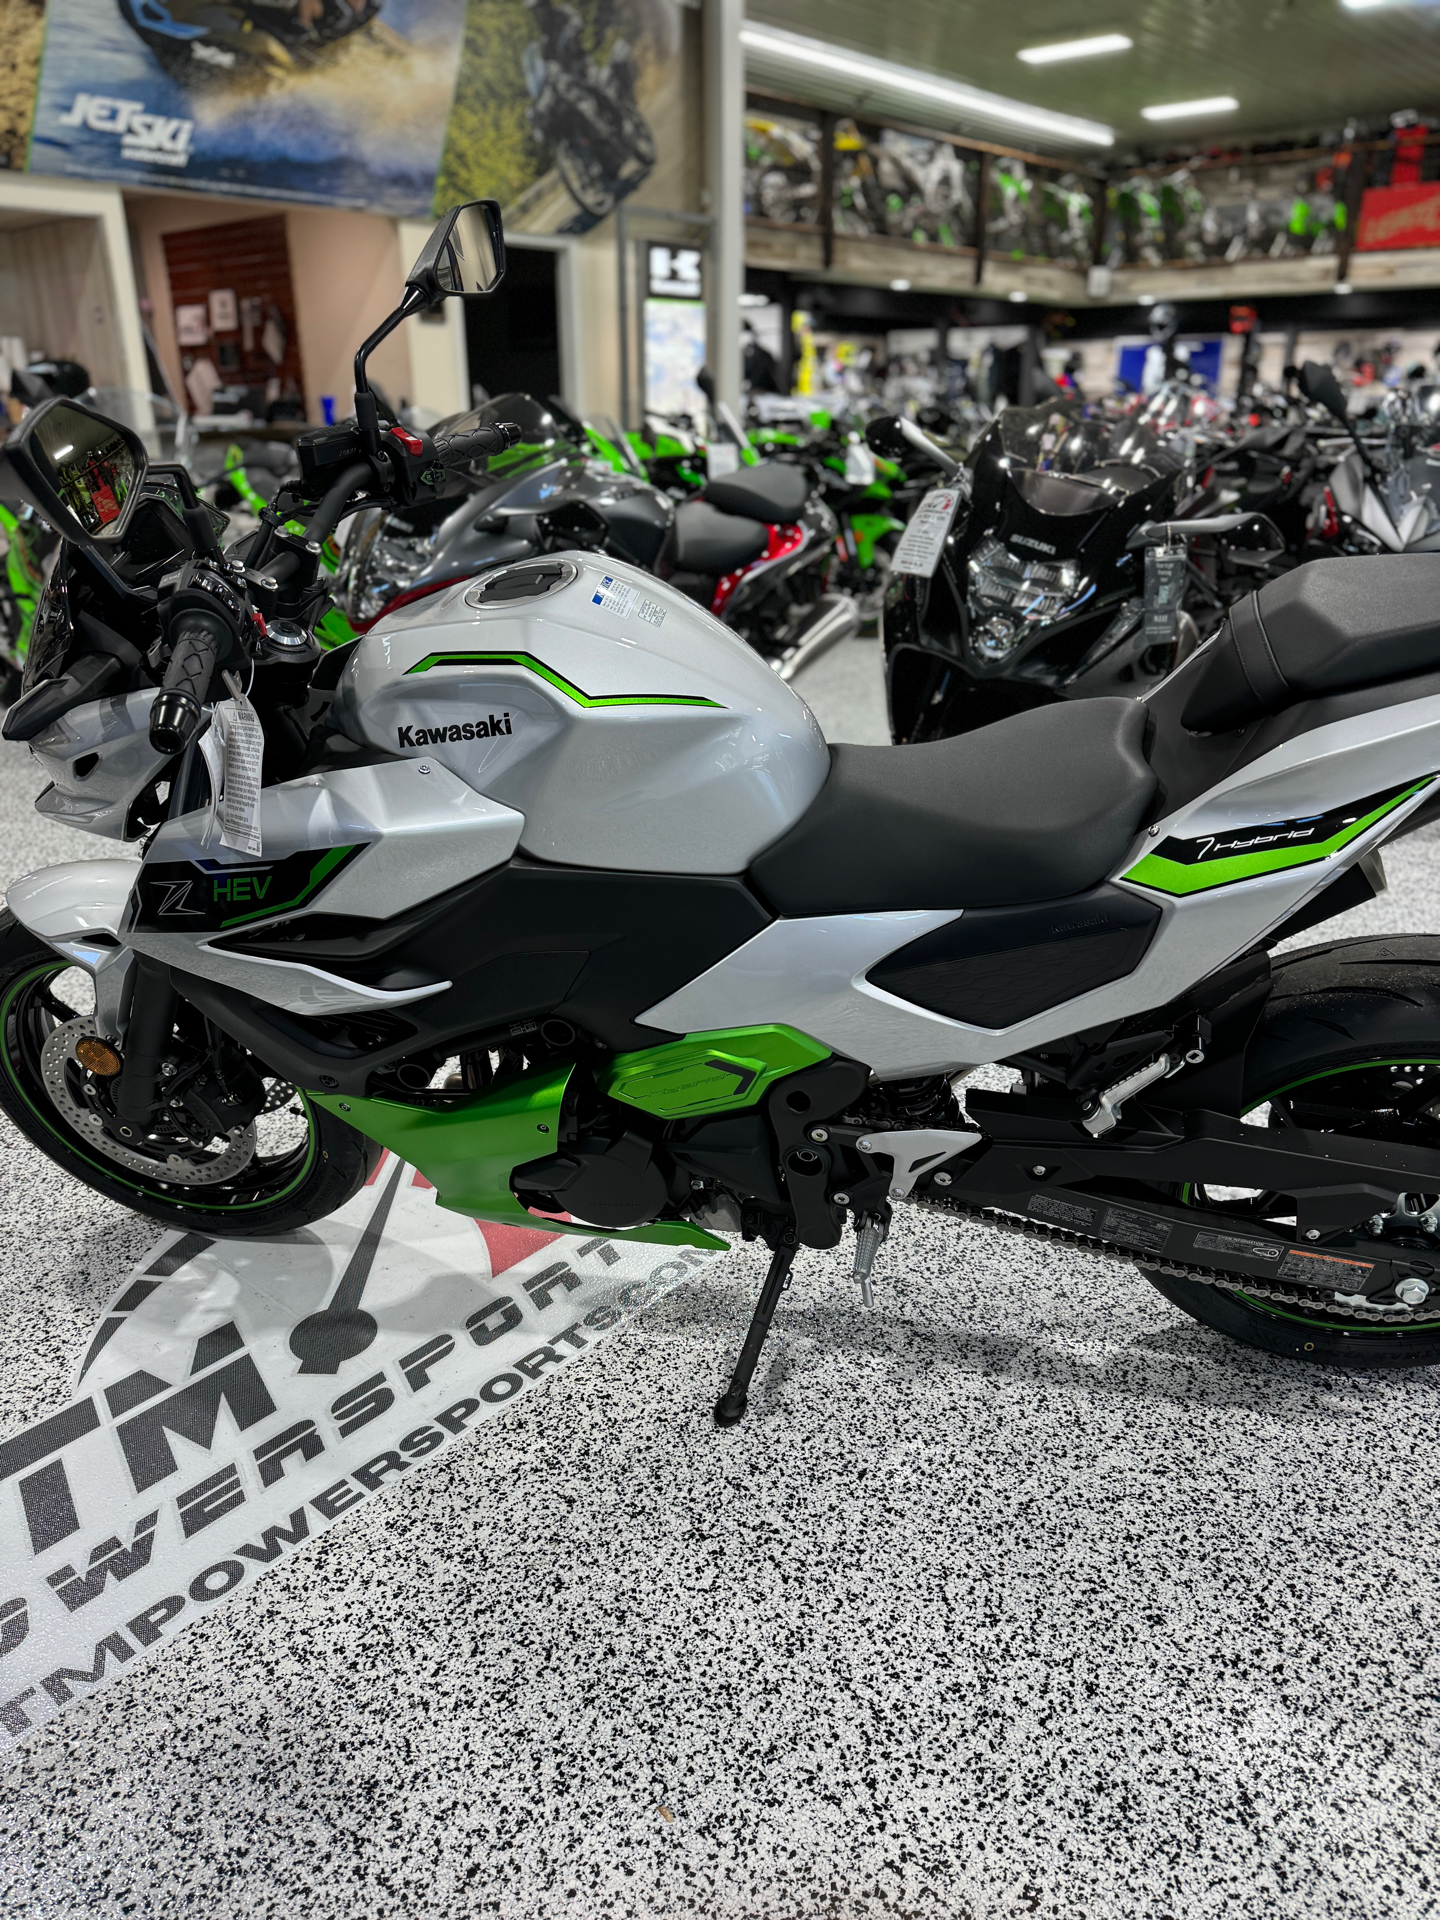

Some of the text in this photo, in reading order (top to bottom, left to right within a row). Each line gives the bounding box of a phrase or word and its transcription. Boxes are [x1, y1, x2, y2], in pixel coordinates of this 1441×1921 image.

[60, 93, 145, 134] JET
[1010, 533, 1056, 555] SUZUKI
[397, 712, 513, 748] Kawasaki
[1196, 827, 1316, 860] 7 Hybrid
[213, 876, 273, 902] HEV
